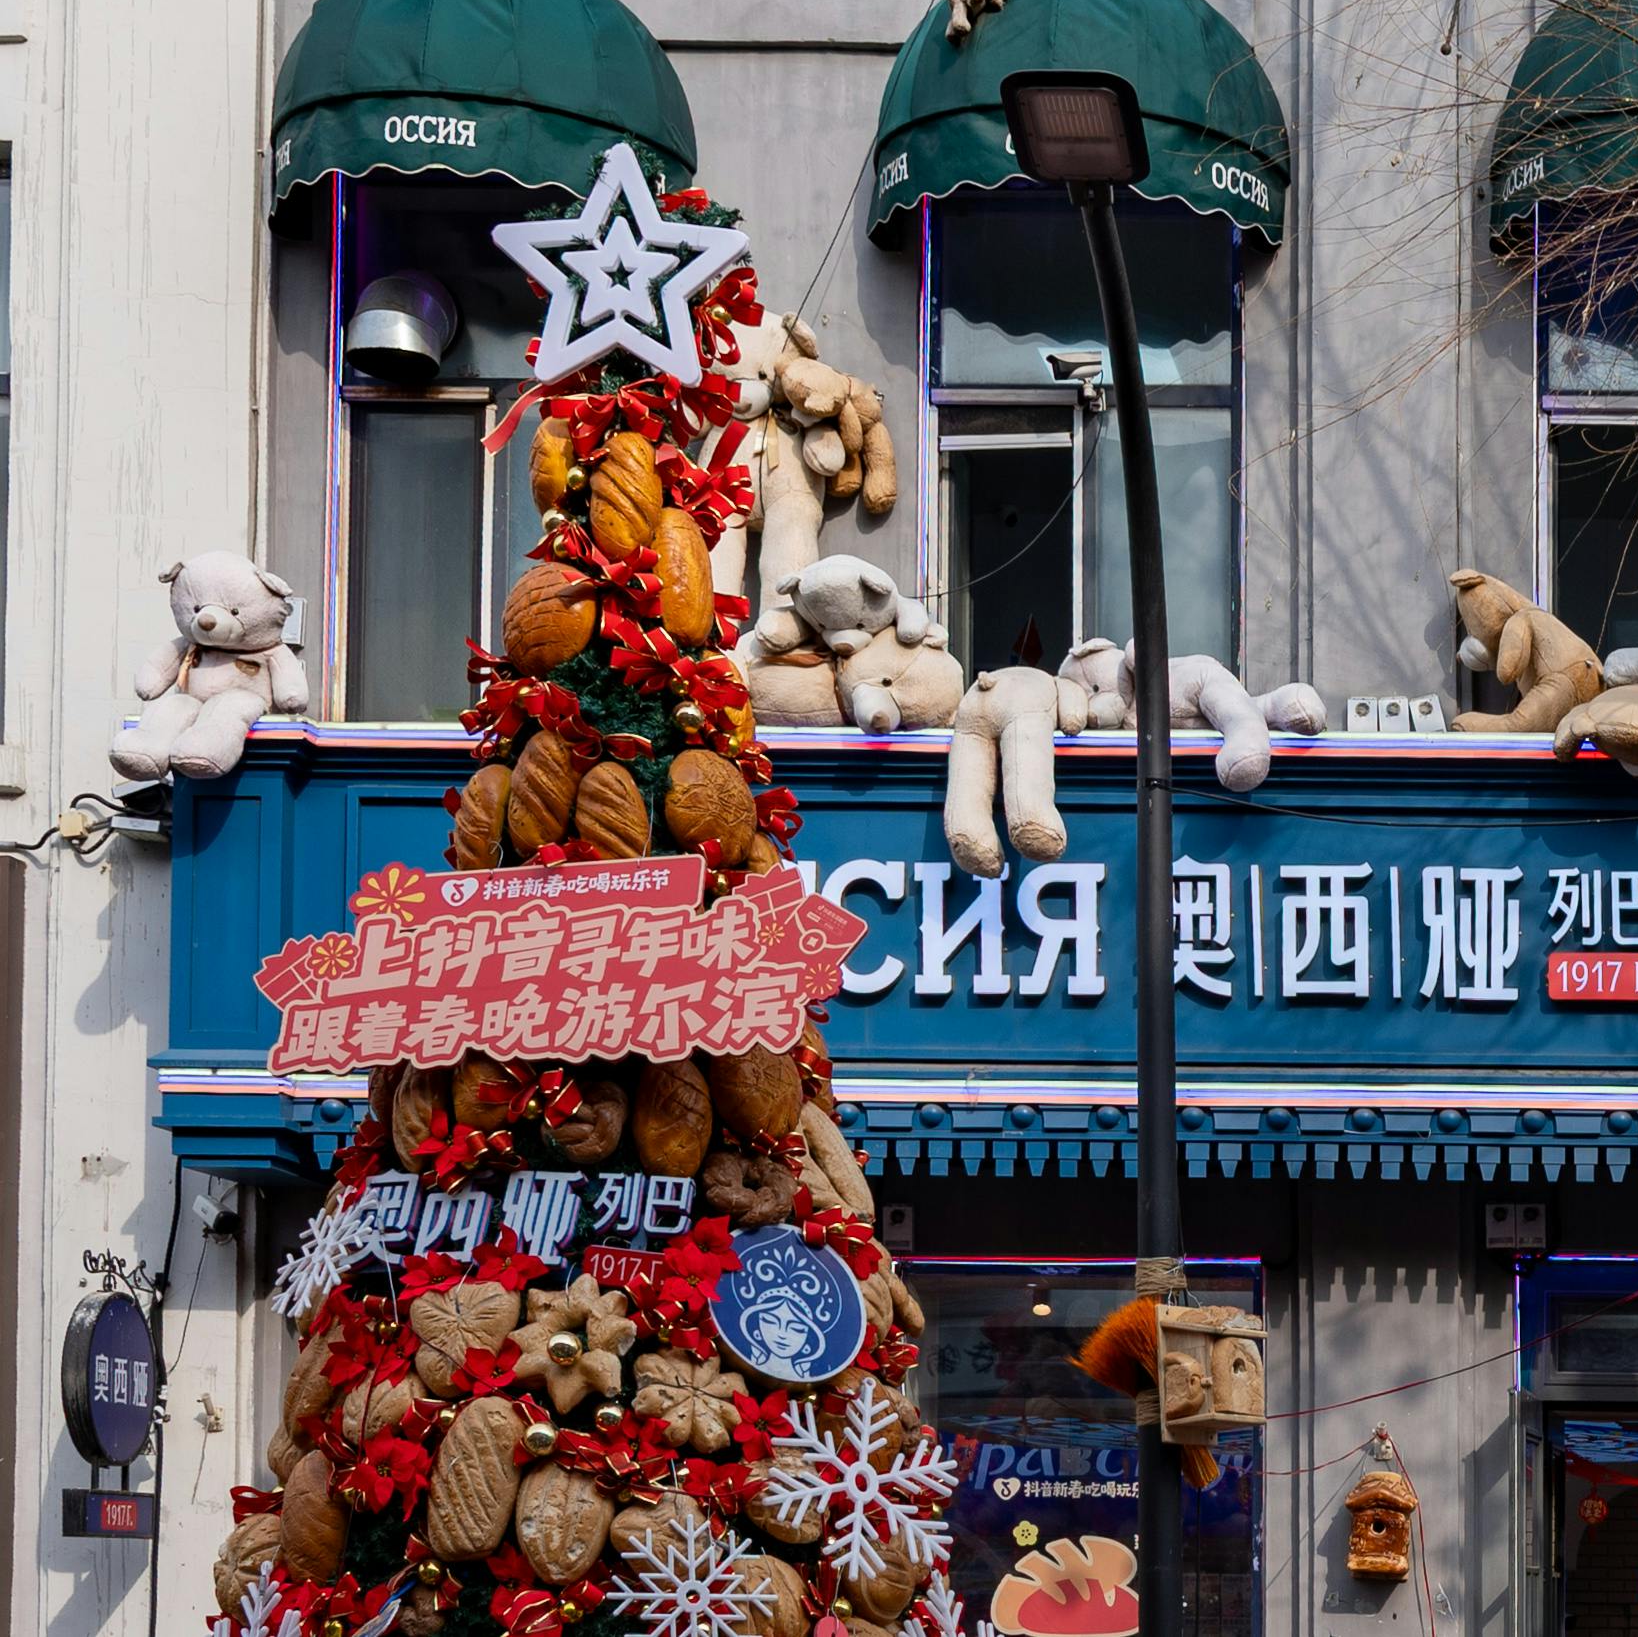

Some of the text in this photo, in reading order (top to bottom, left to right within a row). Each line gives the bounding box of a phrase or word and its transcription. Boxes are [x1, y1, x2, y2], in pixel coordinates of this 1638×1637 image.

[385, 115, 477, 147] ОССИЯ
[1211, 162, 1270, 212] ОССИЯ
[483, 869, 670, 901] 抖音新春吃喝玩乐节
[327, 905, 754, 998] 上抖音寻年味
[1556, 960, 1623, 994] 1917
[278, 973, 799, 1064] 跟着春晚游尔滨
[593, 1171, 697, 1235] 列巴
[589, 1252, 643, 1280] 1917
